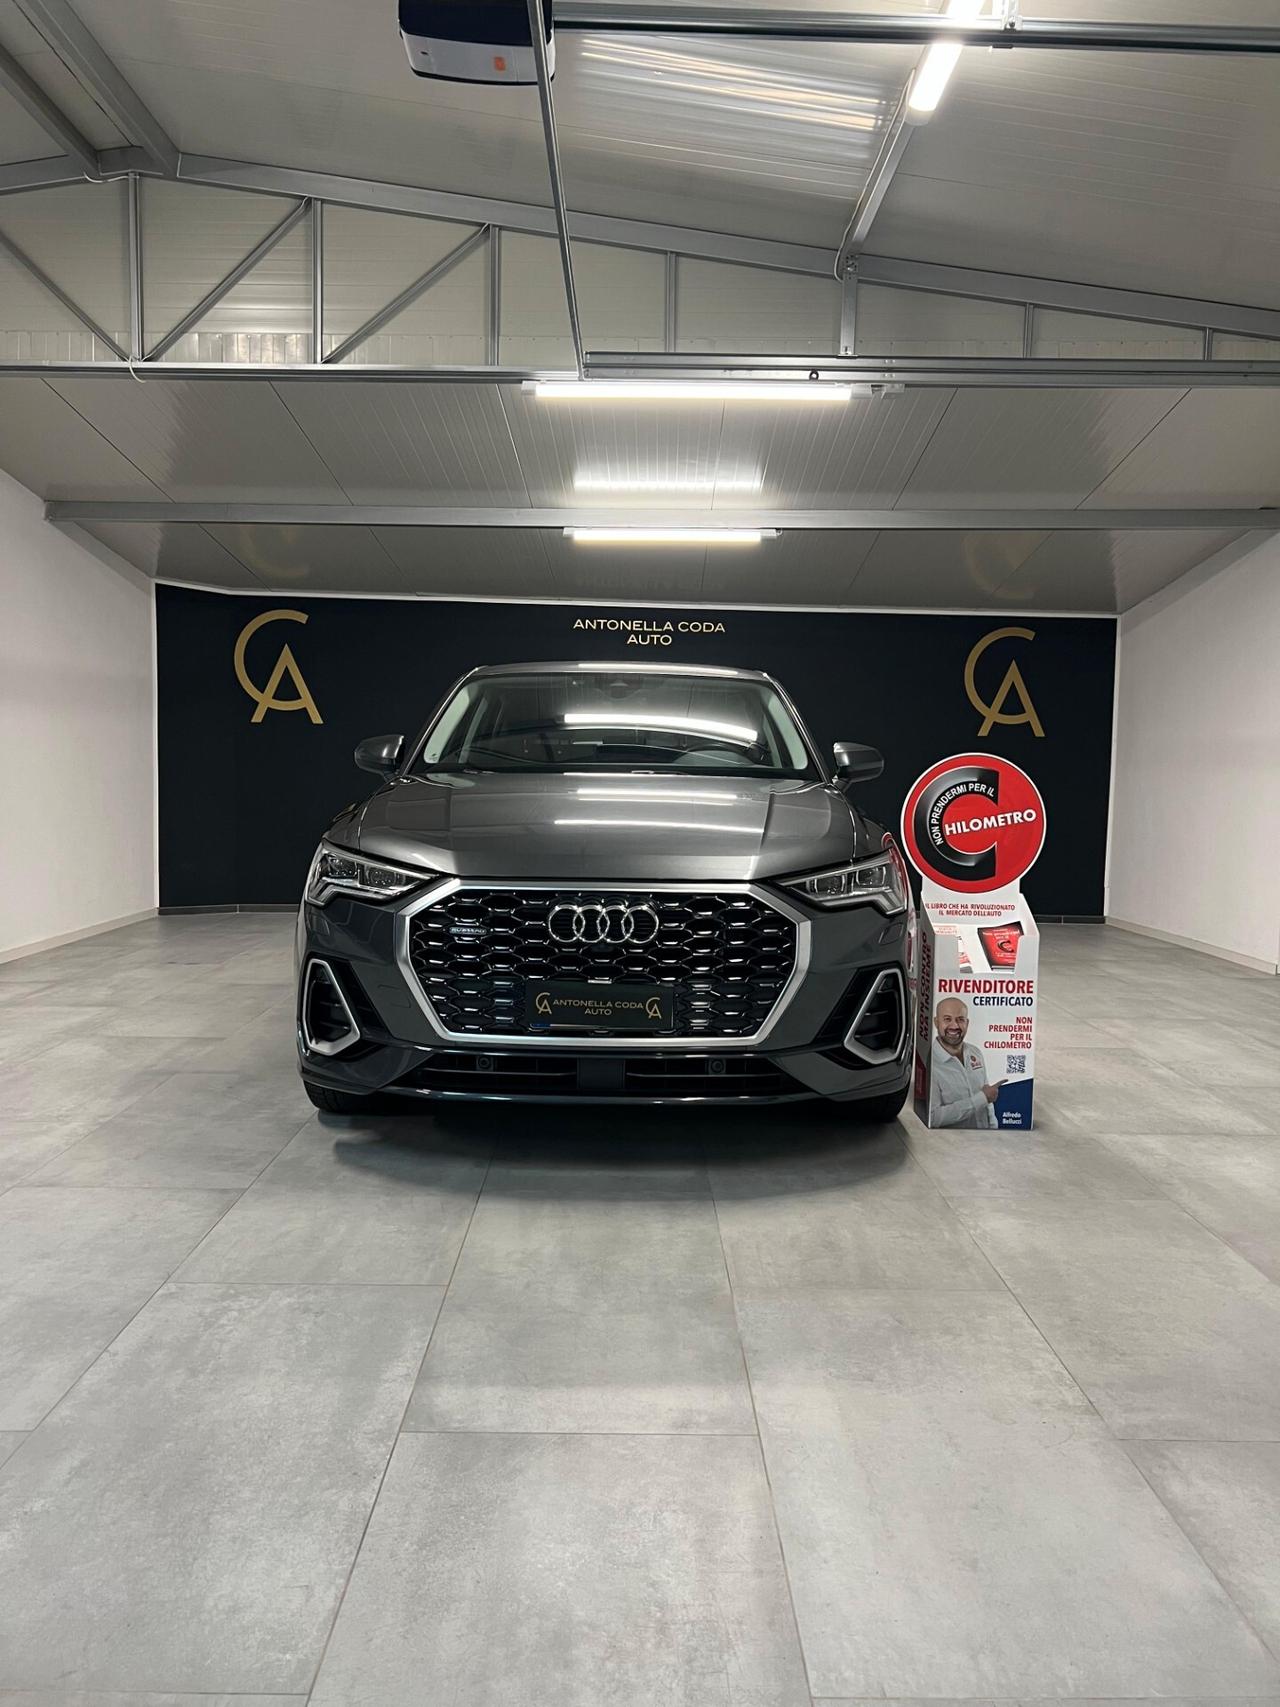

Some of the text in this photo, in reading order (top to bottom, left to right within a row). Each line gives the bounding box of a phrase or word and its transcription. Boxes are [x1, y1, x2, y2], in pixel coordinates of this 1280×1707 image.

[573, 619, 725, 633] ANTONELLA CODA
[627, 634, 672, 646] AUTO
[931, 783, 995, 846] NON PRENDERMI PER IL
[970, 903, 1016, 911] RIVOLUZIONATO
[938, 979, 1034, 994] RIVENDITORE
[552, 999, 644, 1010] ANTONELLA CODA
[973, 996, 1033, 1007] CERTIFICATO
[584, 1008, 612, 1016] AUTO
[1015, 1016, 1033, 1024] NON
[988, 1024, 1033, 1033] PRENDERMI
[1010, 1033, 1024, 1041] PER
[984, 1041, 1032, 1049] CHILOMETRO
